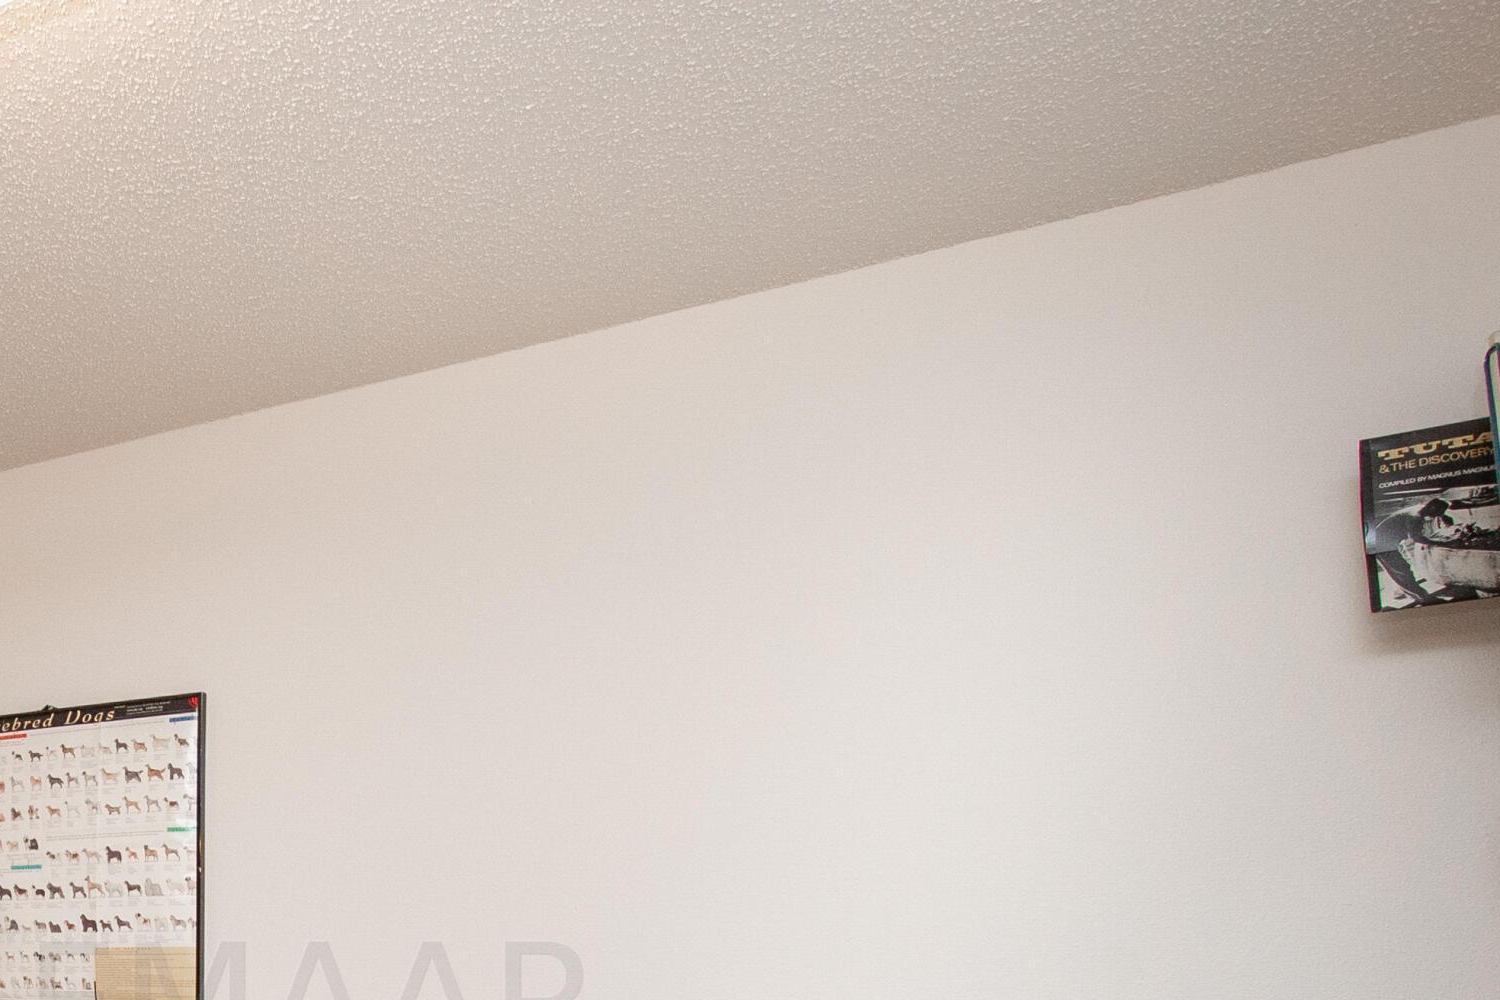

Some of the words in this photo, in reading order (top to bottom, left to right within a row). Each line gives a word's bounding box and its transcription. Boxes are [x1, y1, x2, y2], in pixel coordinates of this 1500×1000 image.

[1378, 464, 1390, 474] &
[1390, 458, 1417, 472] THE
[1378, 478, 1416, 489] COMPILED
[1428, 470, 1462, 480] MAGNUS
[64, 707, 115, 726] Dogs
